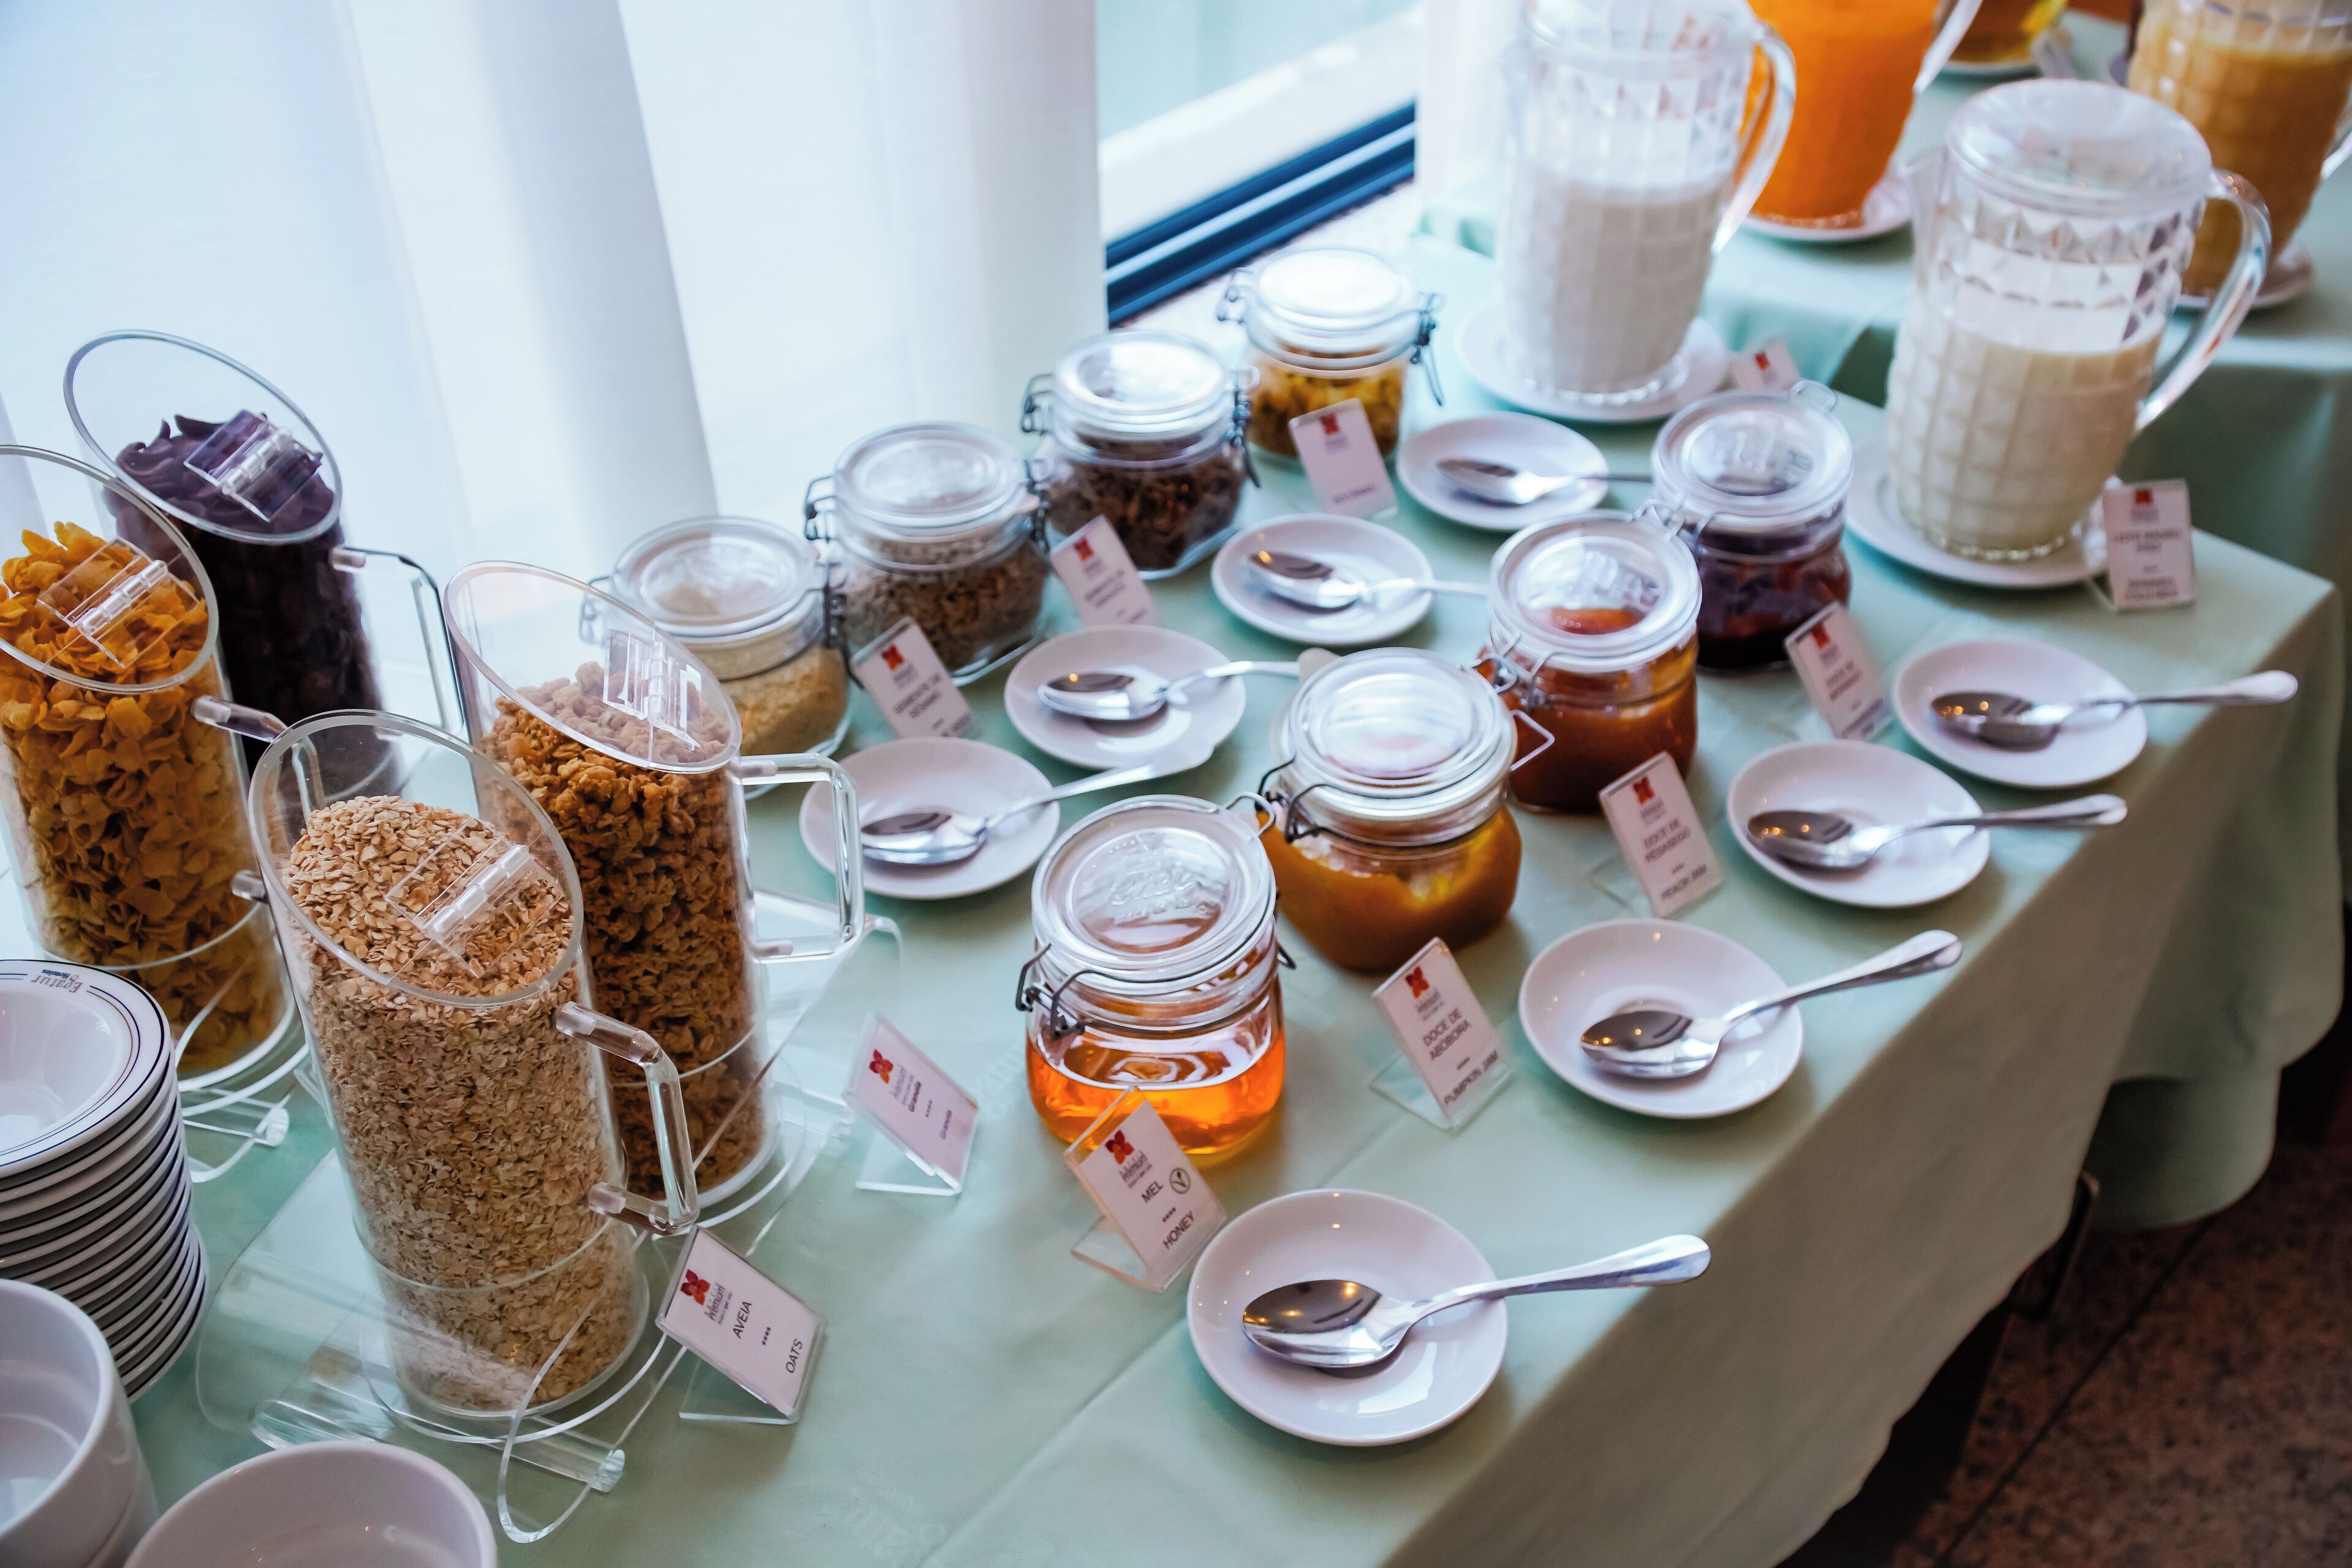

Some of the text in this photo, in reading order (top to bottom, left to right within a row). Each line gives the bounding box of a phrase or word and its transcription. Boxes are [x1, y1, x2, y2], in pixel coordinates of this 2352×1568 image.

[30, 974, 83, 993] Egatur
[1423, 1007, 1463, 1047] DOCE DE
[1444, 1049, 1499, 1105] PUMPKIN JAM
[1141, 1180, 1164, 1204] MEL
[1163, 1210, 1194, 1250] HONEY
[733, 1301, 753, 1339] AVEIA
[786, 1338, 803, 1373] OATS
